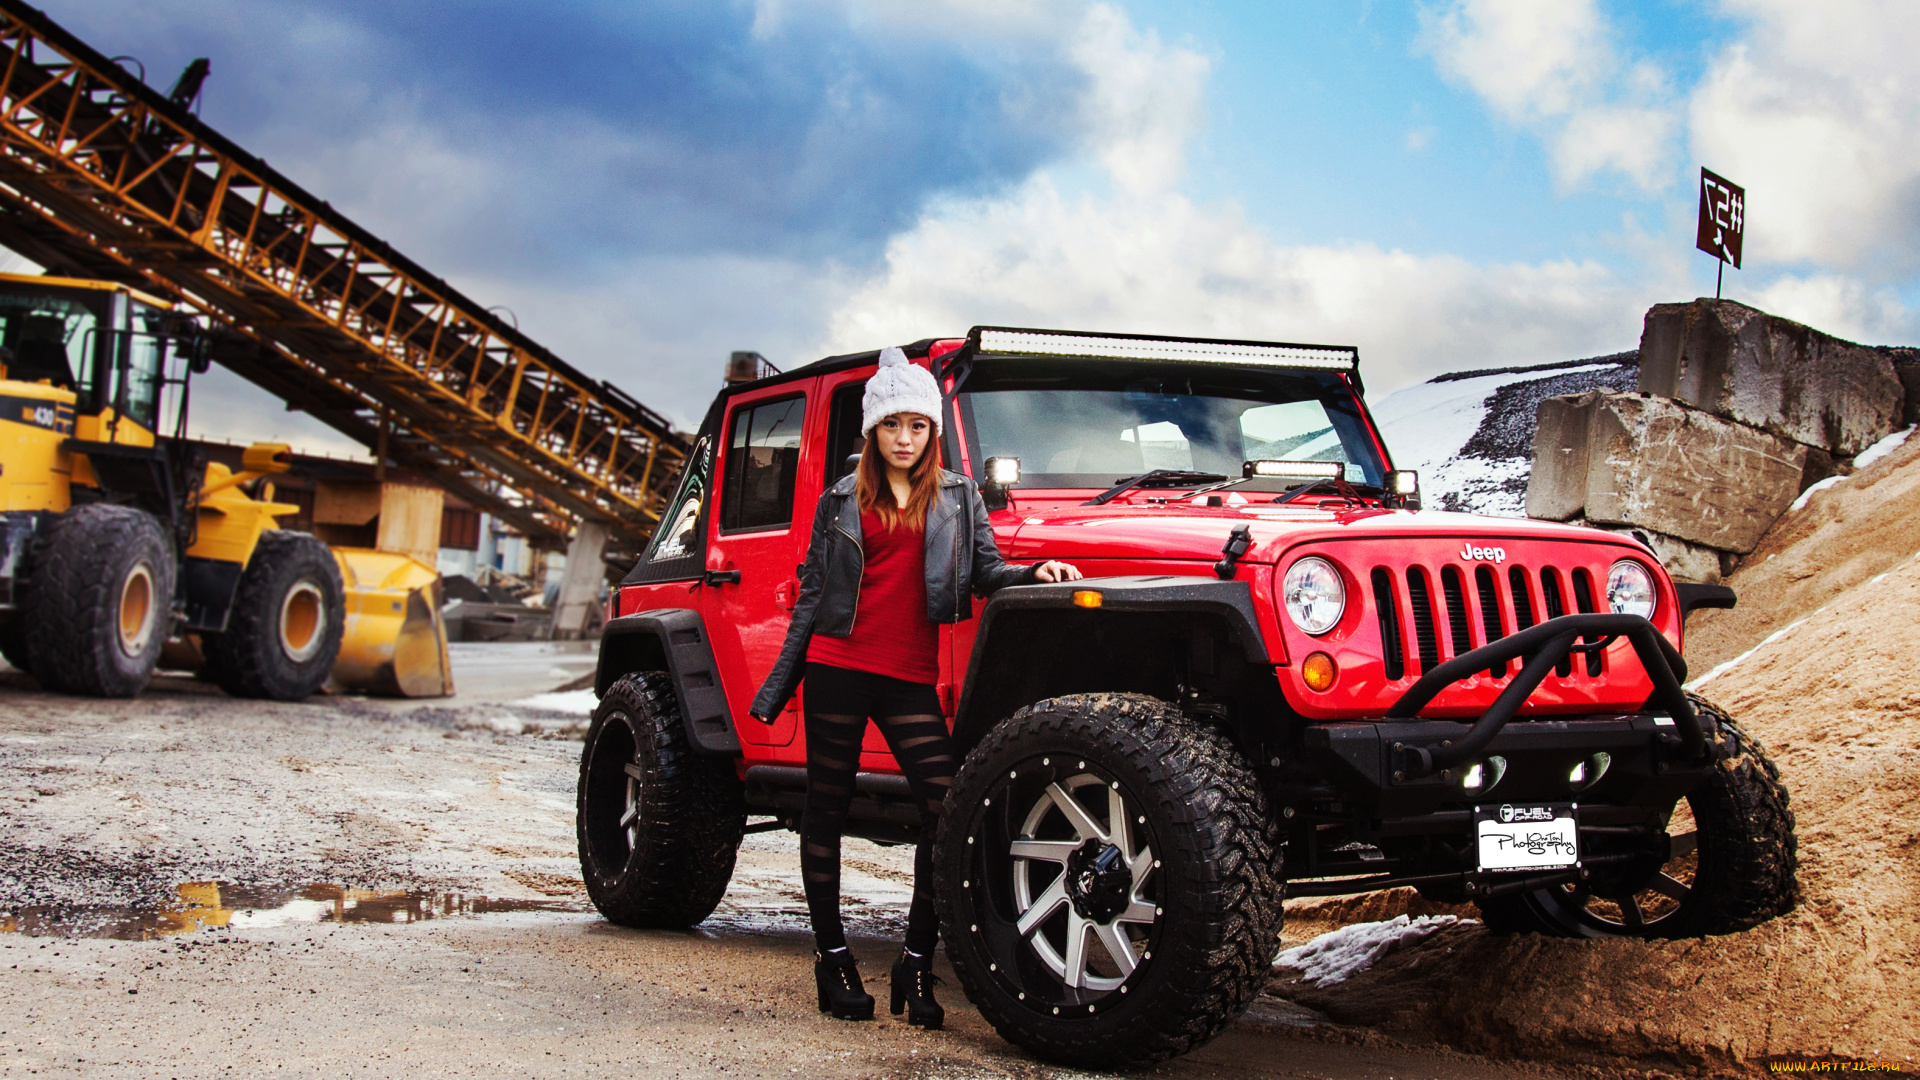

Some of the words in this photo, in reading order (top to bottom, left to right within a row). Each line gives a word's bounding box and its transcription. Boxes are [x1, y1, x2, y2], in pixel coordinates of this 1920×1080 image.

[1460, 542, 1506, 564] Jeep
[1514, 807, 1551, 816] FUEL
[1480, 832, 1576, 855] Photography
